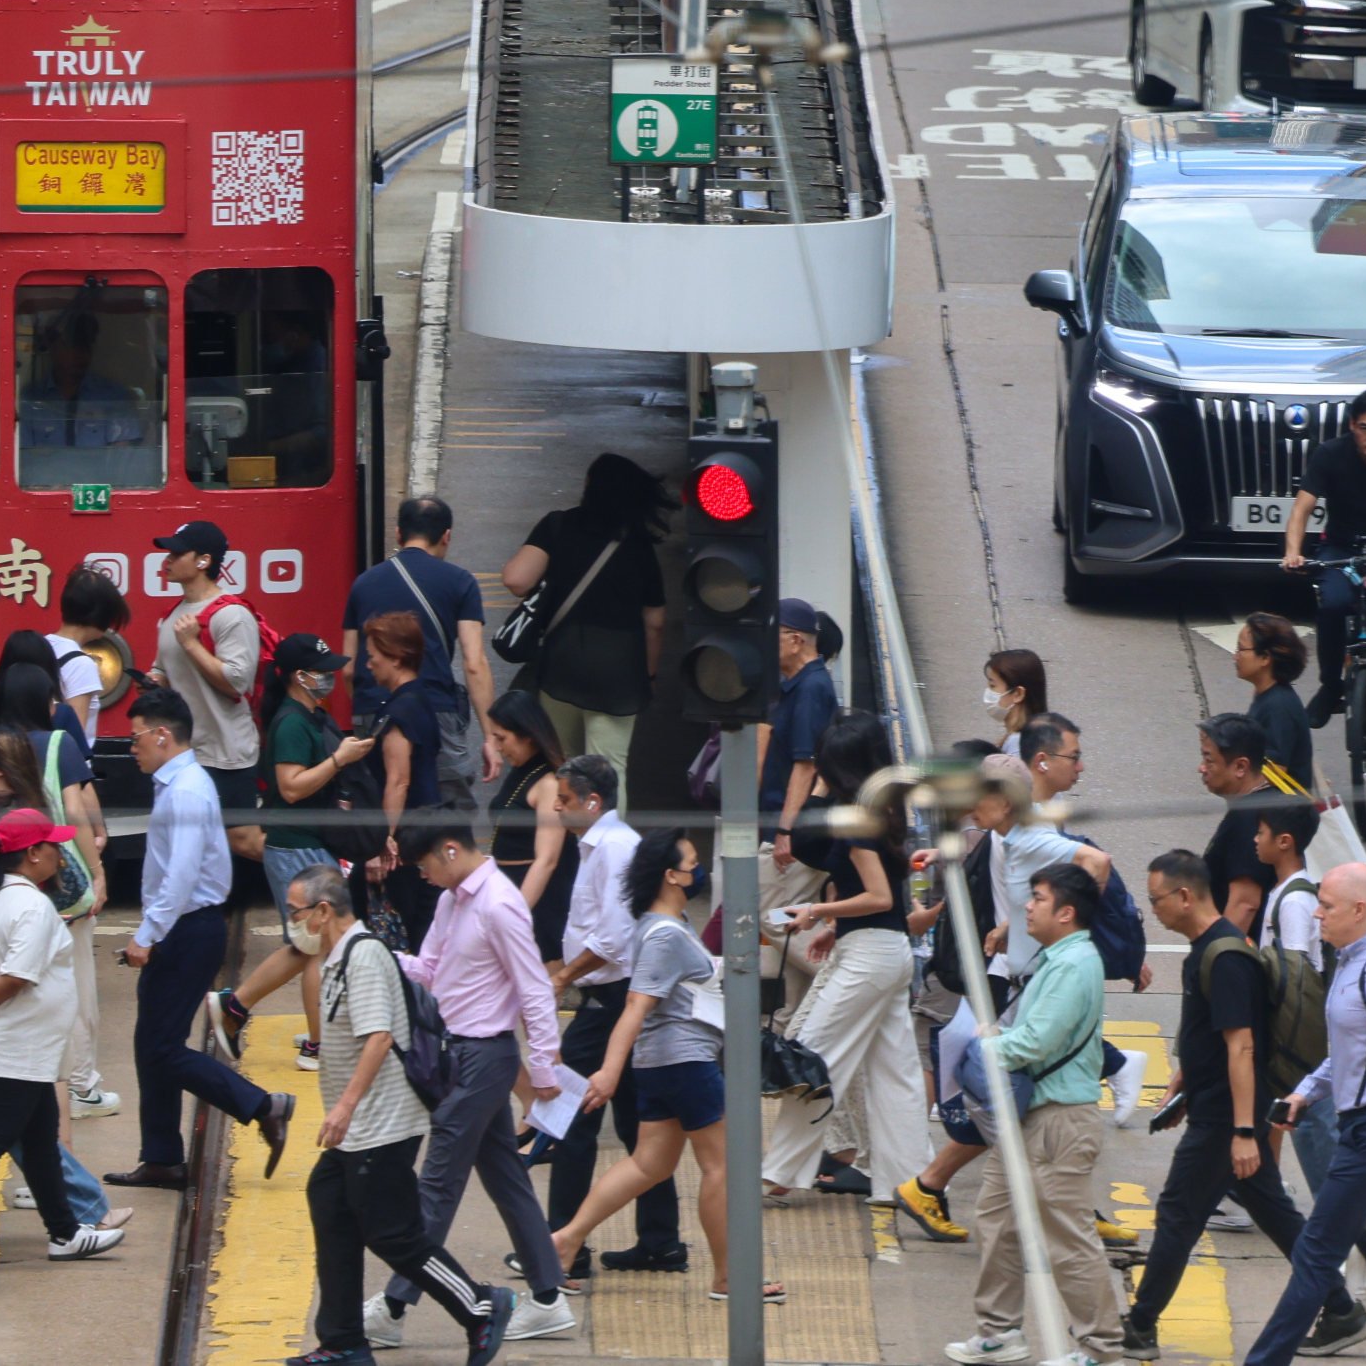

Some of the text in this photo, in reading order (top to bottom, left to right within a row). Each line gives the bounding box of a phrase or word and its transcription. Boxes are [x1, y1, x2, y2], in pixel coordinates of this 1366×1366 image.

[33, 50, 145, 76] TRULY
[669, 65, 711, 78] 畢打街
[26, 82, 152, 107] TAIWAN
[685, 80, 711, 88] Street
[686, 100, 712, 110] 27E
[919, 122, 1107, 148] AD
[24, 143, 161, 170] Causeway Bay
[38, 171, 148, 197] 銅鑼灣
[75, 489, 108, 508] 134
[1247, 503, 1282, 524] BG
